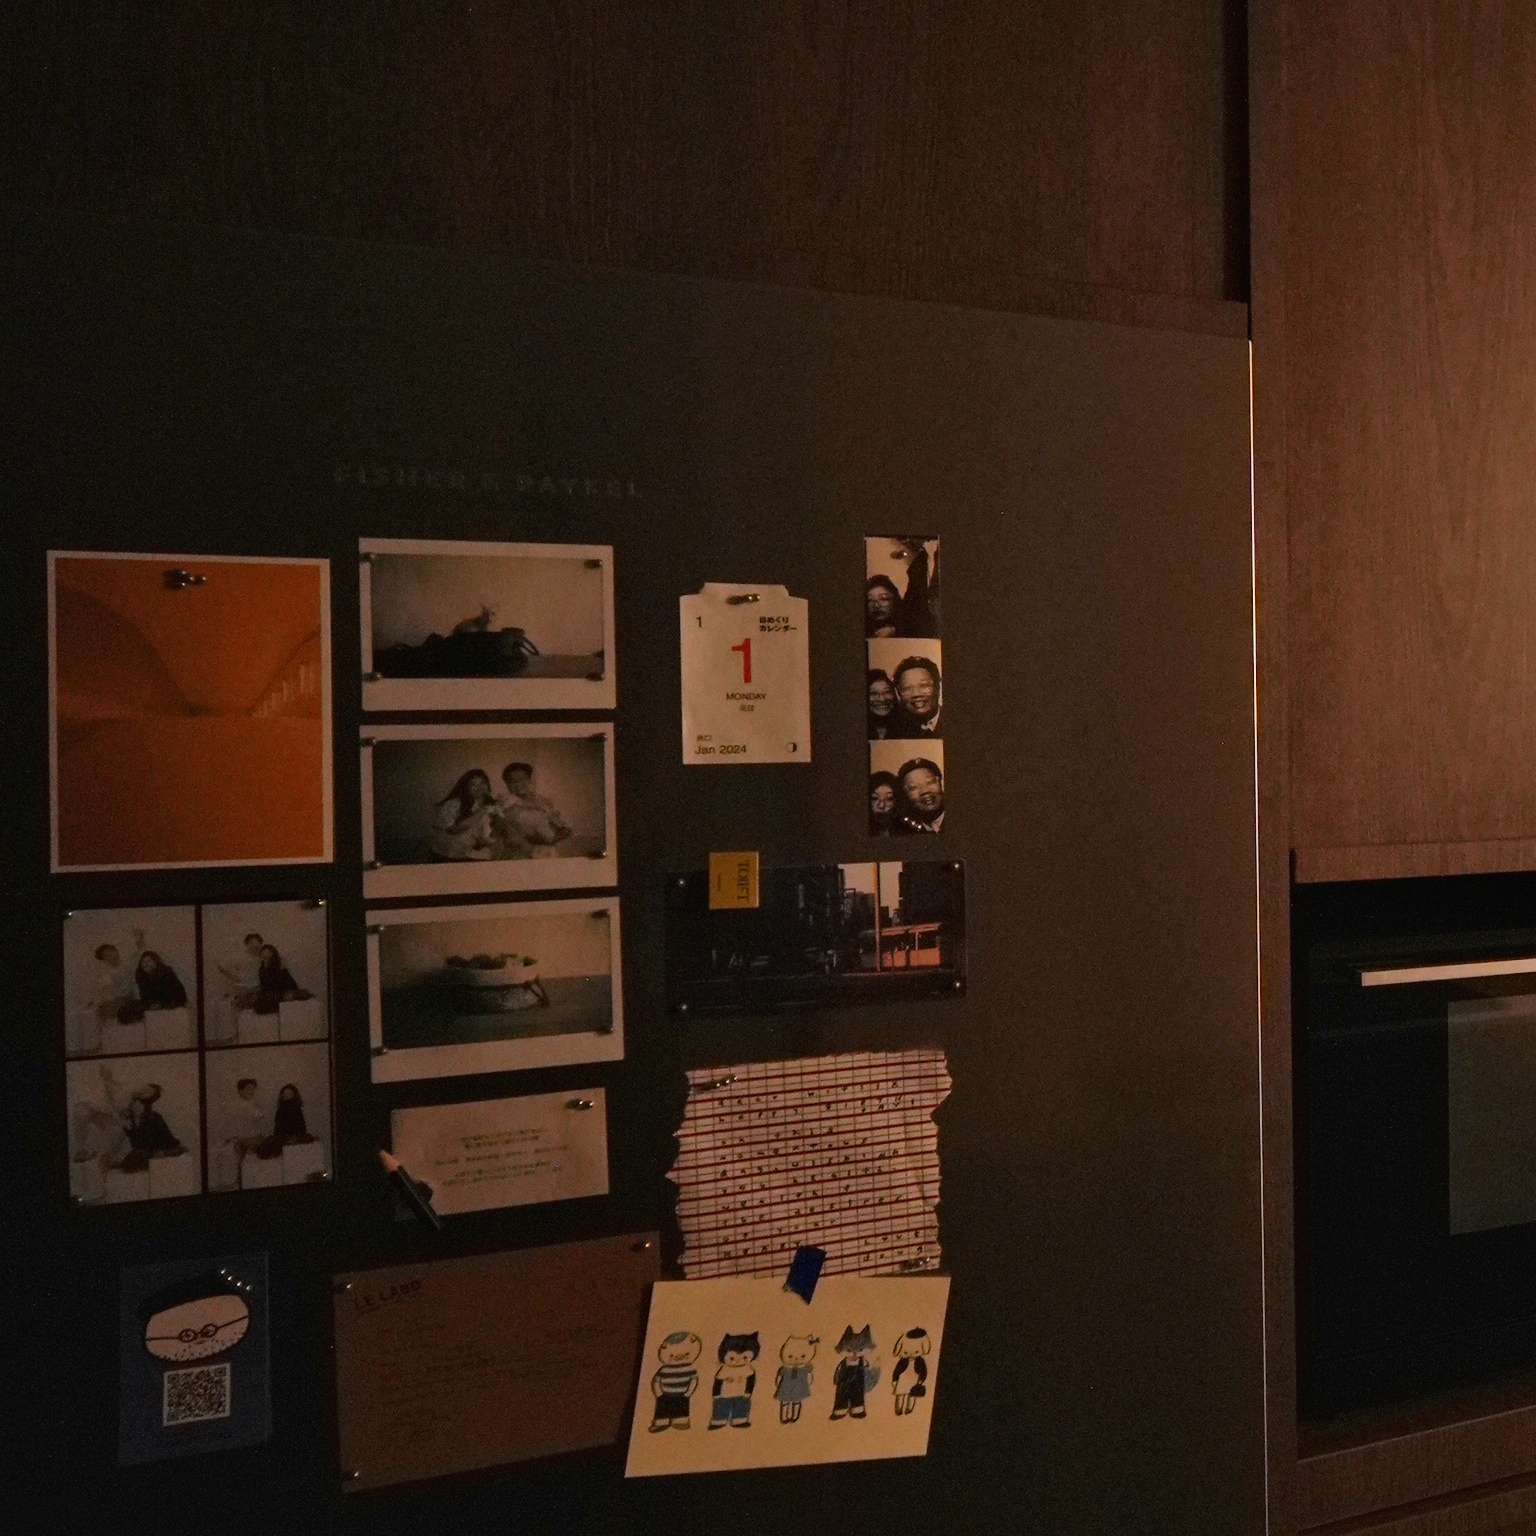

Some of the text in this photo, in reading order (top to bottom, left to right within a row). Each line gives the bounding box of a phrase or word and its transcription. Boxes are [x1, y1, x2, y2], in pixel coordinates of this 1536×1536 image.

[696, 616, 703, 628] 1
[731, 637, 752, 684] 1
[726, 692, 767, 700] MONDAY
[695, 744, 747, 755] Jan 2024
